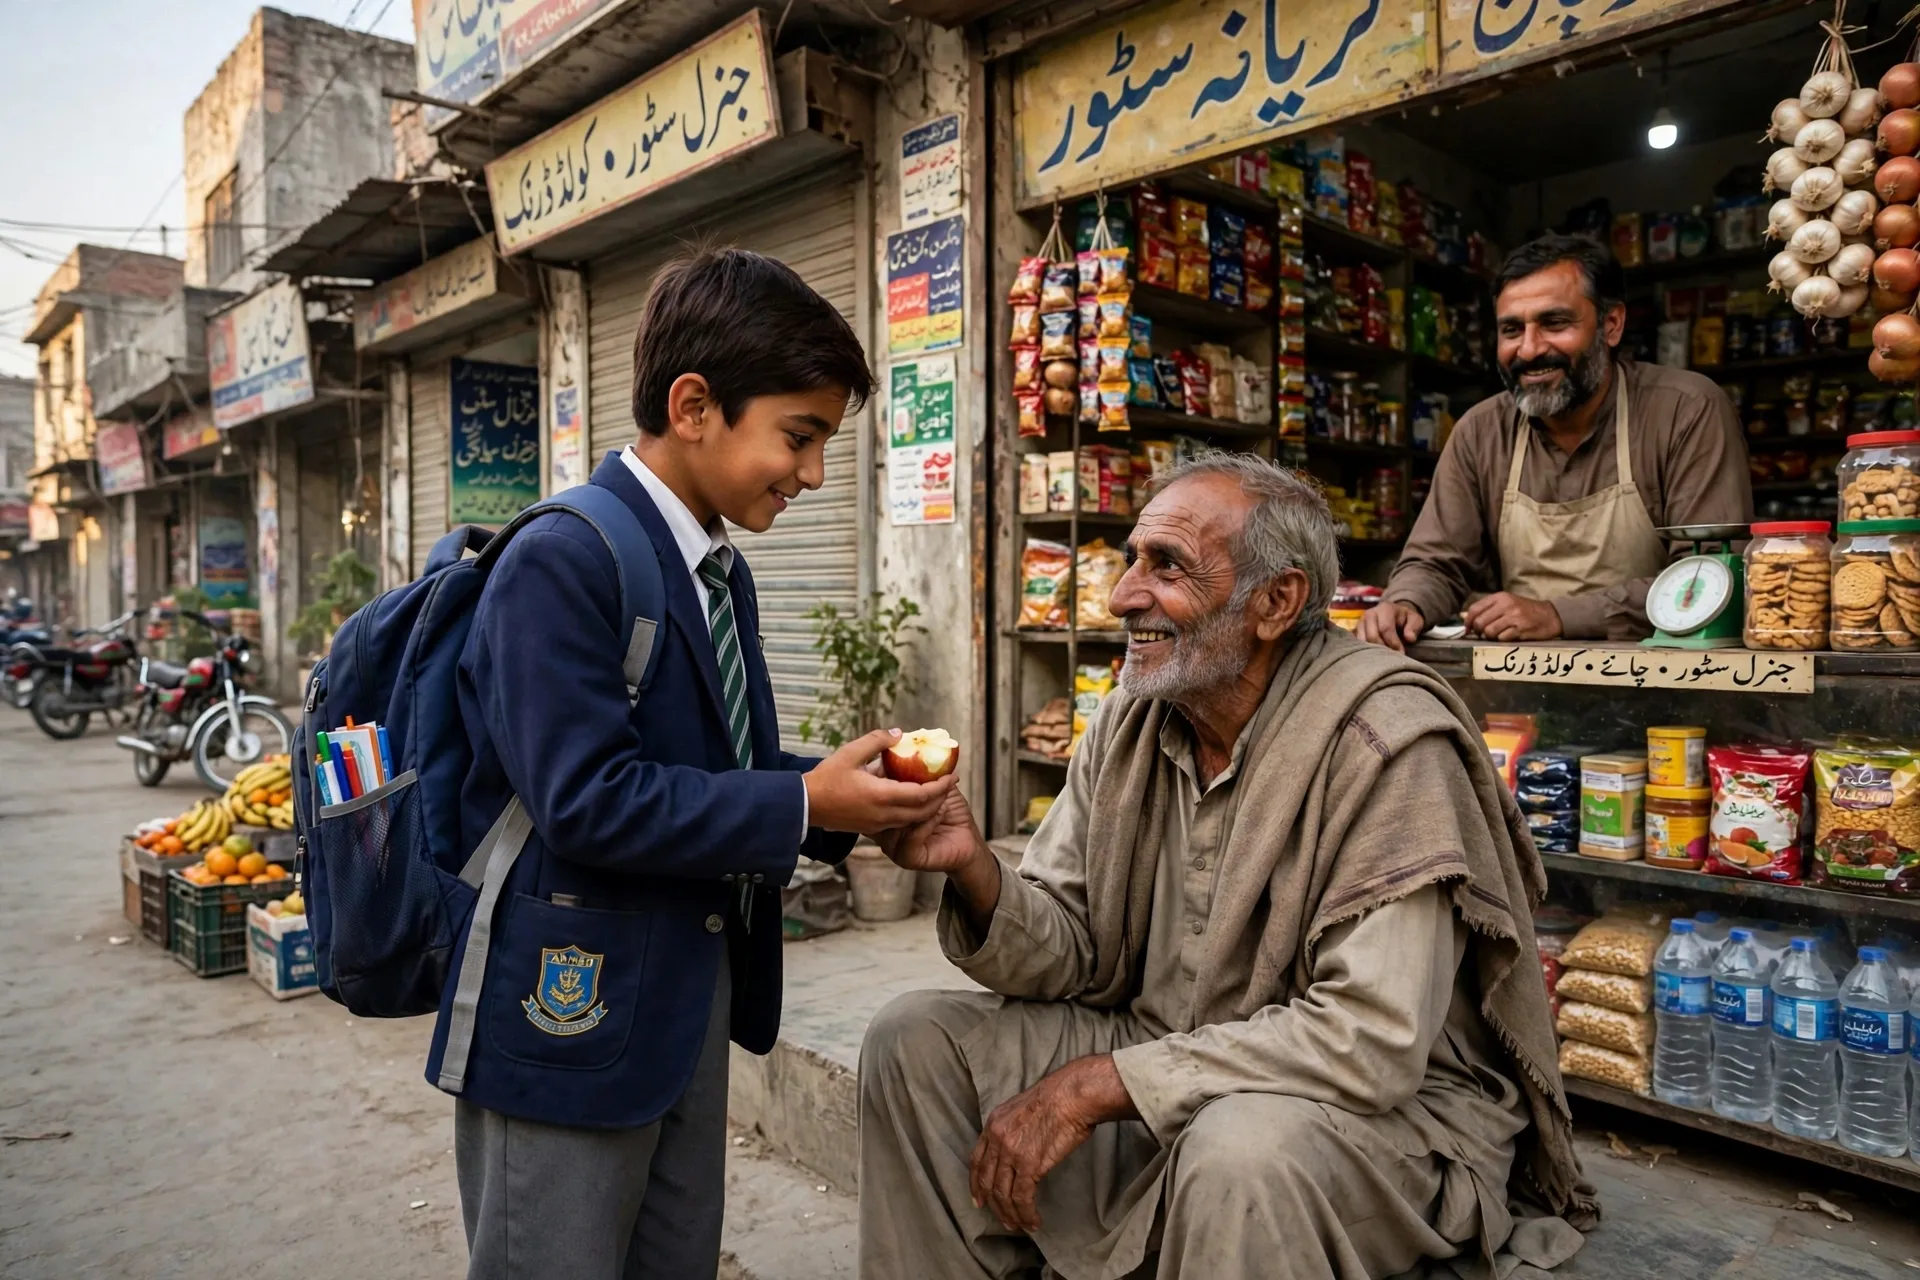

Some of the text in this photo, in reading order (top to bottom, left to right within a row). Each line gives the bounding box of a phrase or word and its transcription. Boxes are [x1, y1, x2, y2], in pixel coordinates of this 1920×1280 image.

[1038, 0, 1380, 173] ریانہ سٹور
[682, 58, 750, 153] جنرل
[625, 92, 676, 179] سٹور
[1484, 647, 1537, 675] ڈرنک
[1541, 649, 1587, 677] کولڈ
[1674, 654, 1729, 682] سٹور
[1733, 654, 1796, 687] جنرل
